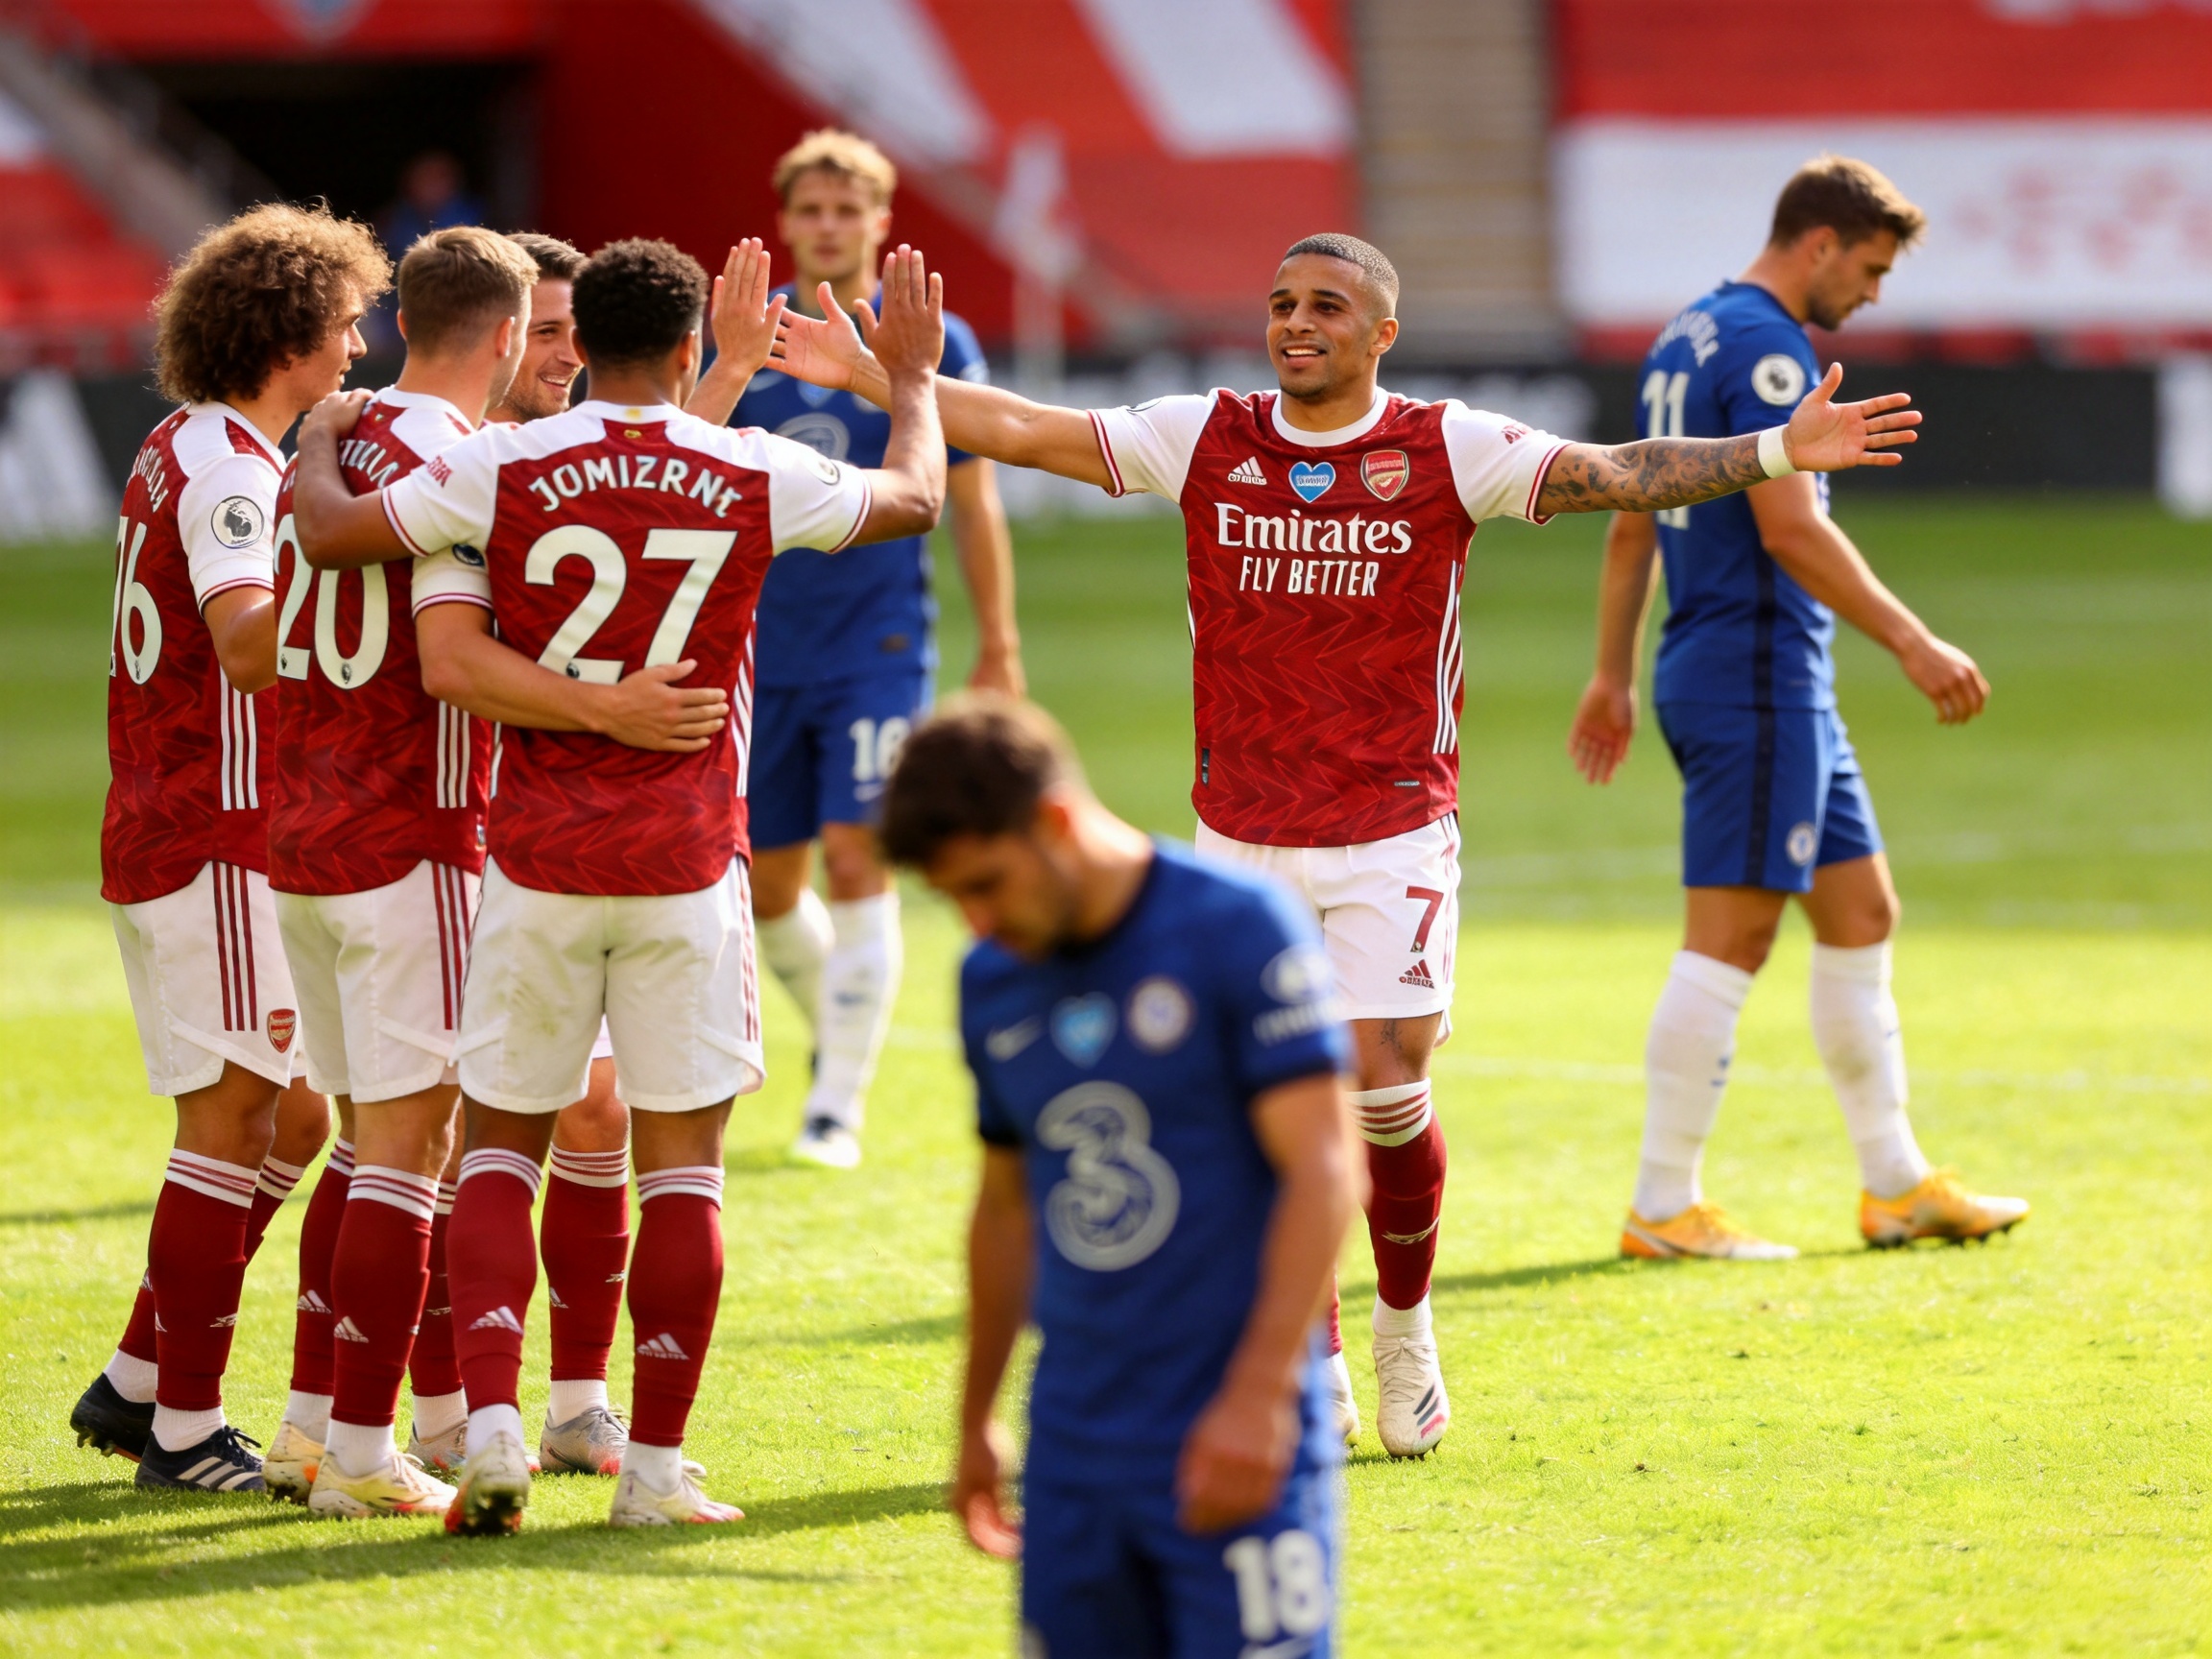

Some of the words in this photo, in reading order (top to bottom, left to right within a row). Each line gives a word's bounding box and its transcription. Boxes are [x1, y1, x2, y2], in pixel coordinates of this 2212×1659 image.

[1642, 370, 1690, 530] 11
[1214, 502, 1412, 554] Emirates
[1239, 555, 1281, 593] FLY
[1287, 559, 1380, 597] BETTER
[274, 514, 390, 690] 20
[525, 524, 738, 685] 27
[1406, 885, 1444, 952] 7
[1222, 1528, 1333, 1642] 18
